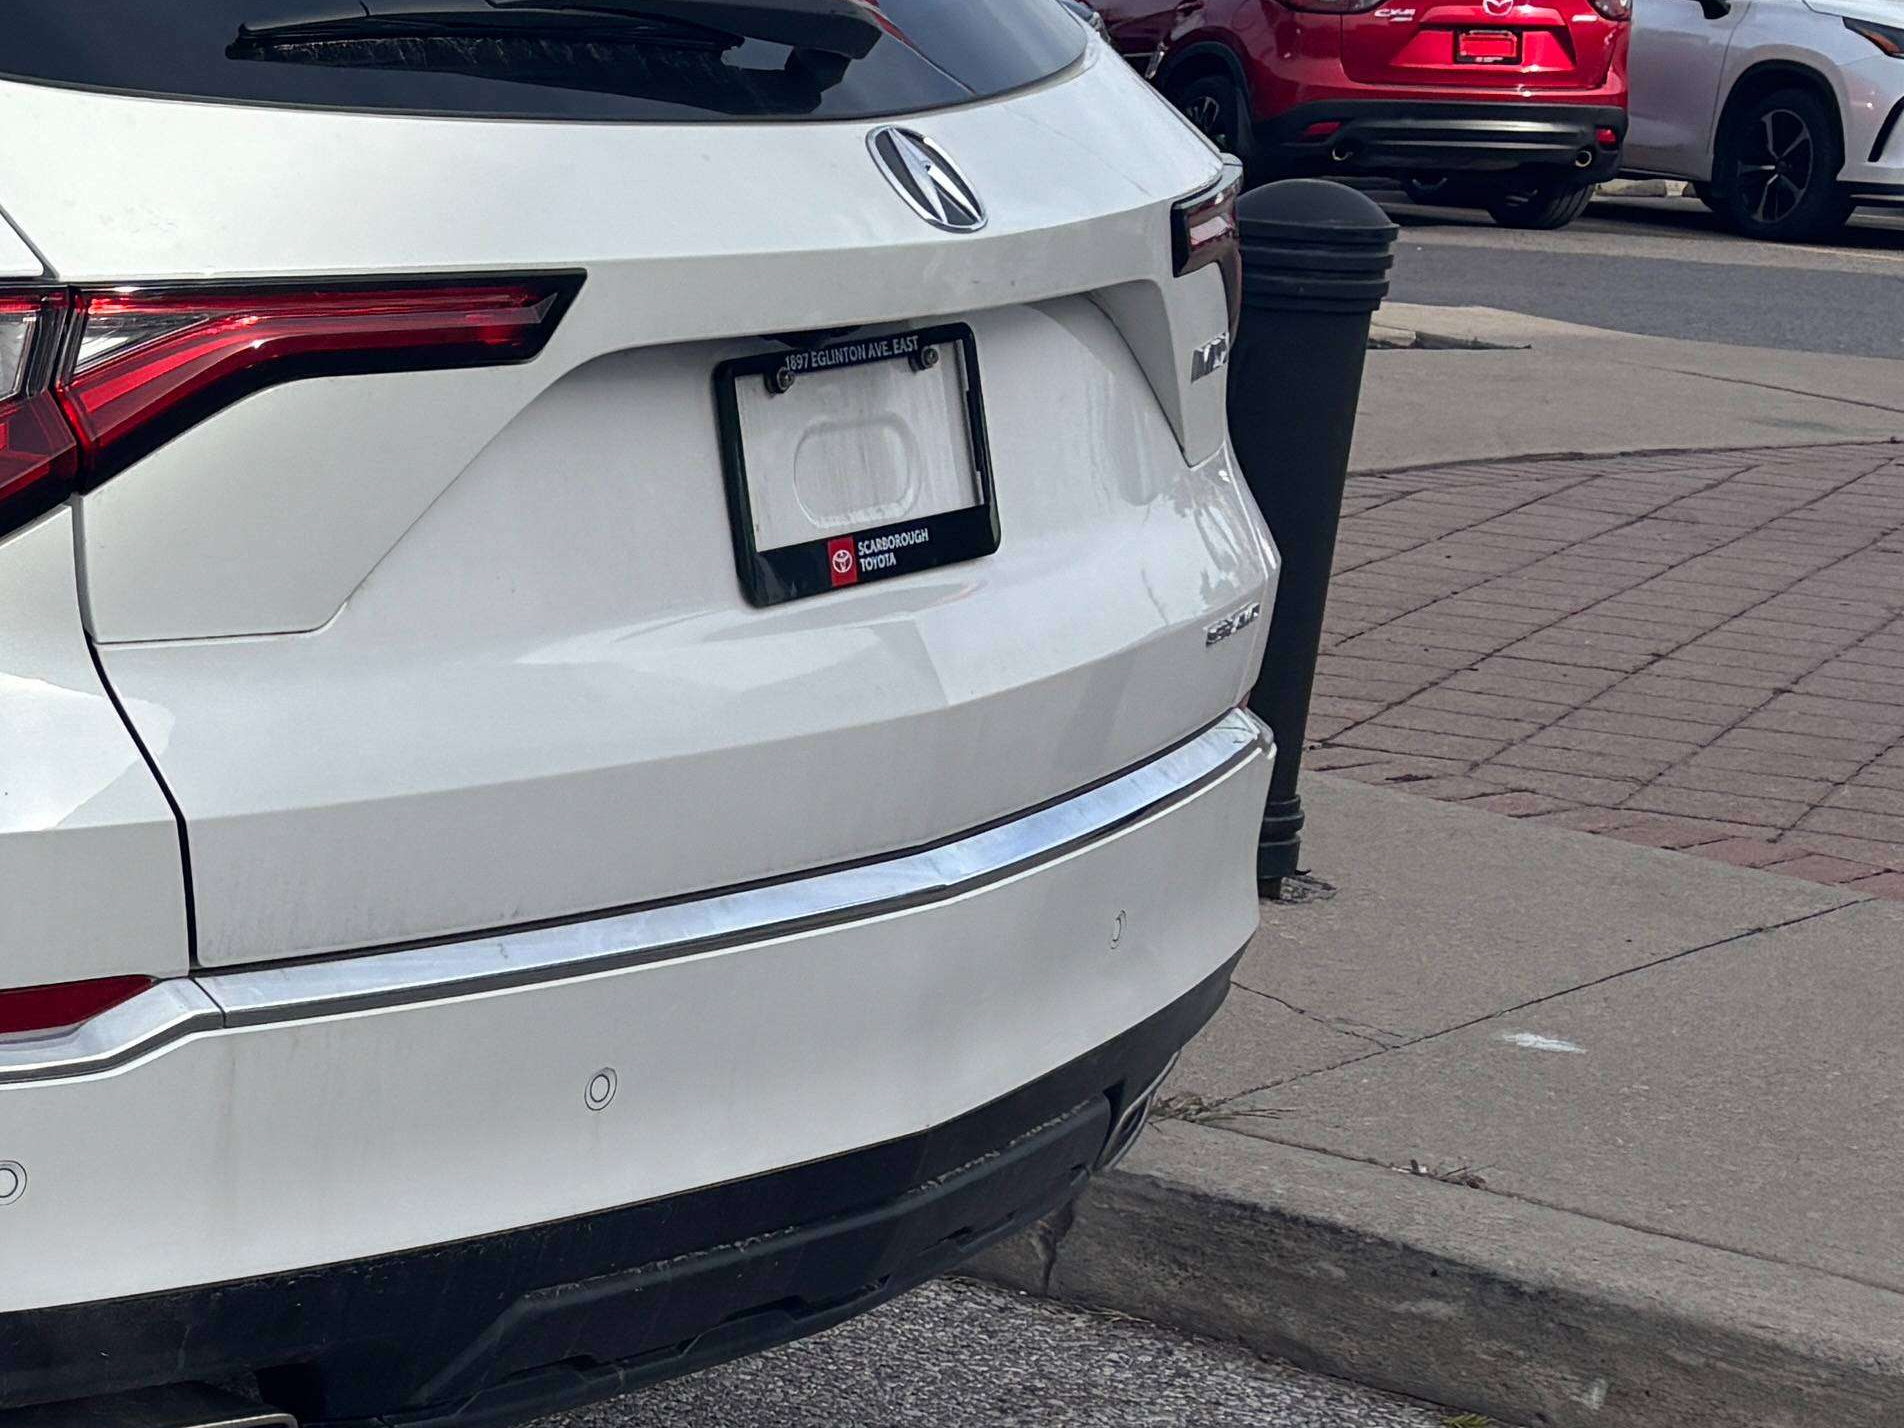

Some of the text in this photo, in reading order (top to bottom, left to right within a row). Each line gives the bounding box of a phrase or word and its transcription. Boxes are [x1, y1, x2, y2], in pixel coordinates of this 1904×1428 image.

[785, 335, 919, 371] 1897 EGLINTON AVE. EAST
[858, 528, 929, 556] SCARBOROUGH
[860, 552, 897, 573] TOYOTA
